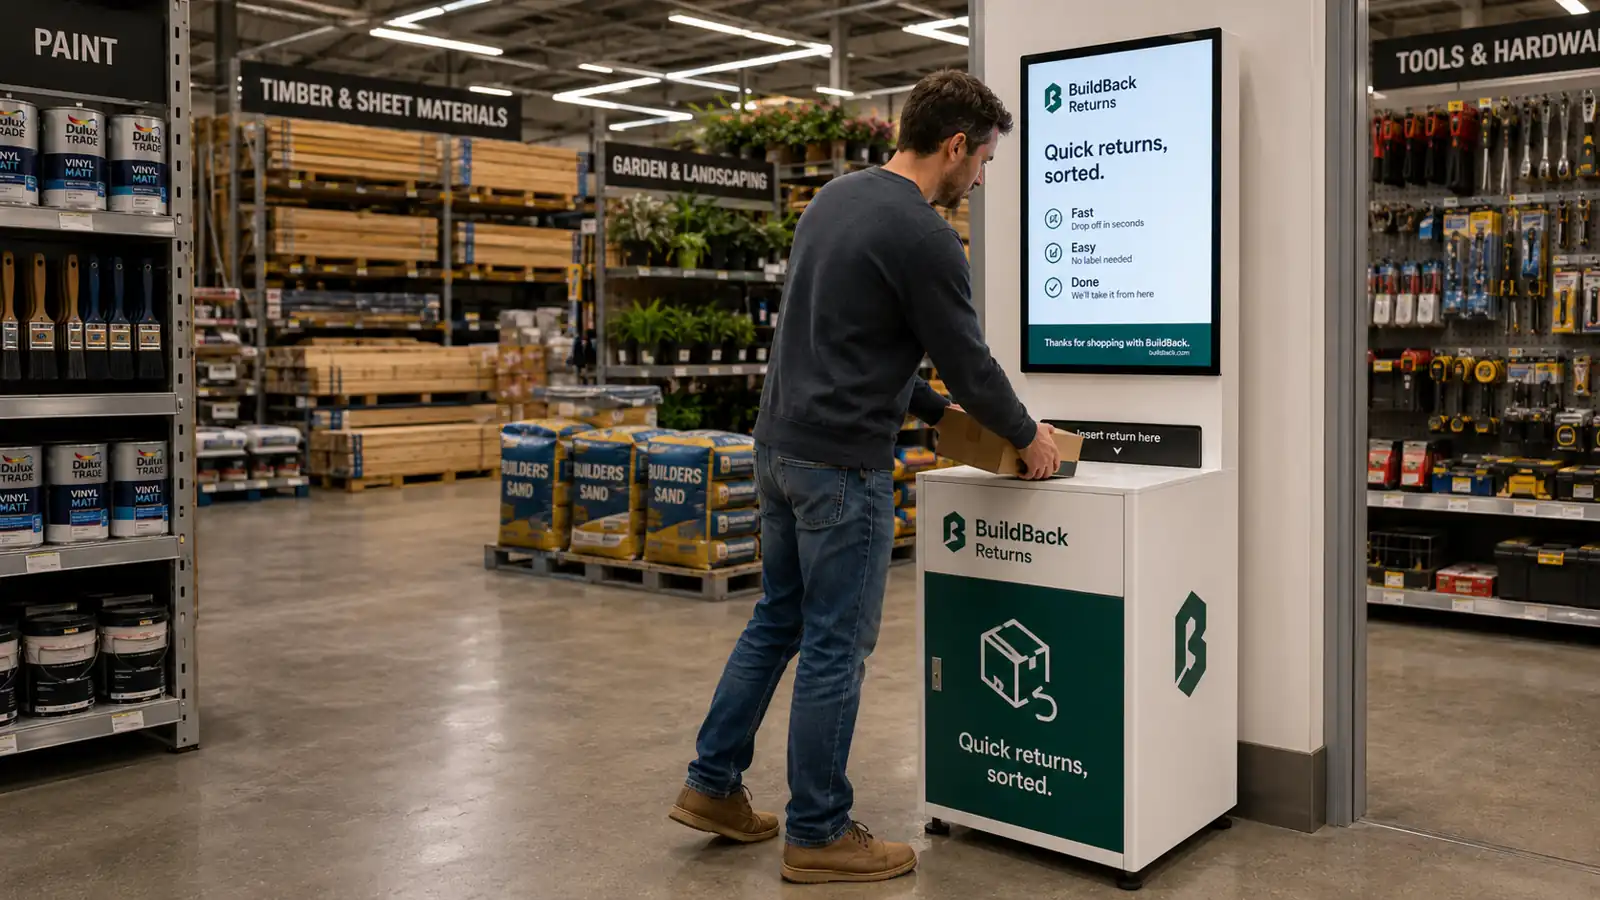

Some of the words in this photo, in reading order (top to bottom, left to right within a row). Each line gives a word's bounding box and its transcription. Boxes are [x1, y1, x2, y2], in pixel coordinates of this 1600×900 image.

[34, 27, 118, 66] PAINT
[1396, 44, 1464, 74] TOOLS
[1470, 42, 1488, 66] &
[1494, 28, 1600, 64] HARDWA
[1069, 76, 1137, 96] BuildBack
[260, 77, 334, 108] TIMBER
[338, 87, 352, 110] &
[356, 90, 412, 116] SHEET
[416, 97, 508, 128] MATERIALS
[1069, 98, 1116, 113] Returns
[66, 123, 98, 136] Dulux
[65, 135, 98, 146] TRADE
[132, 131, 161, 144] Dulux
[132, 142, 161, 153] TRADE
[1044, 140, 1094, 162] Quick
[1099, 138, 1168, 156] returns,
[65, 158, 94, 169] VINYL
[65, 168, 92, 178] MATT
[132, 165, 158, 176] VINYL
[612, 155, 668, 180] GARDEN
[670, 162, 680, 181] &
[683, 164, 768, 190] LANDSCAPING
[1044, 162, 1104, 184] sorted.
[132, 174, 157, 184] MATT
[1071, 207, 1094, 218] Fast
[1071, 222, 1090, 232] Drop
[1091, 221, 1102, 230] off
[1103, 220, 1110, 229] in
[1112, 219, 1144, 228] seconds
[1071, 242, 1096, 254] Easy
[1071, 256, 1082, 264] No
[1084, 256, 1102, 264] label
[1103, 255, 1133, 264] needed
[1071, 277, 1100, 288] Done
[1071, 291, 1090, 300] We'll
[1091, 291, 1108, 299] take
[1109, 291, 1115, 299] it
[1116, 290, 1135, 299] from
[1136, 290, 1154, 298] here
[1044, 338, 1072, 347] Thanks
[1074, 338, 1086, 347] for
[1086, 338, 1124, 349] shopping
[1126, 338, 1144, 347] with
[1145, 338, 1190, 347] BuildBack.
[1076, 429, 1104, 440] Insert
[1106, 431, 1136, 442] return
[1138, 432, 1160, 443] here
[2, 463, 33, 473] Dulux
[502, 459, 549, 479] BUILDERS
[574, 462, 624, 481] BUILDERS
[648, 463, 702, 485] BUILDERS
[0, 473, 33, 483] TRADE
[70, 489, 98, 498] VINYL
[135, 485, 160, 494] VINYL
[506, 481, 534, 498] SAND
[580, 484, 609, 501] SAND
[654, 486, 686, 504] SAND
[0, 492, 30, 502] VINYL
[71, 498, 98, 507] MATT
[135, 494, 159, 503] MATT
[976, 518, 1068, 547] BuildBack
[976, 543, 1032, 564] Returns
[958, 732, 1010, 760] Quick
[1015, 746, 1088, 779] returns,
[987, 767, 1052, 797] sorted.
